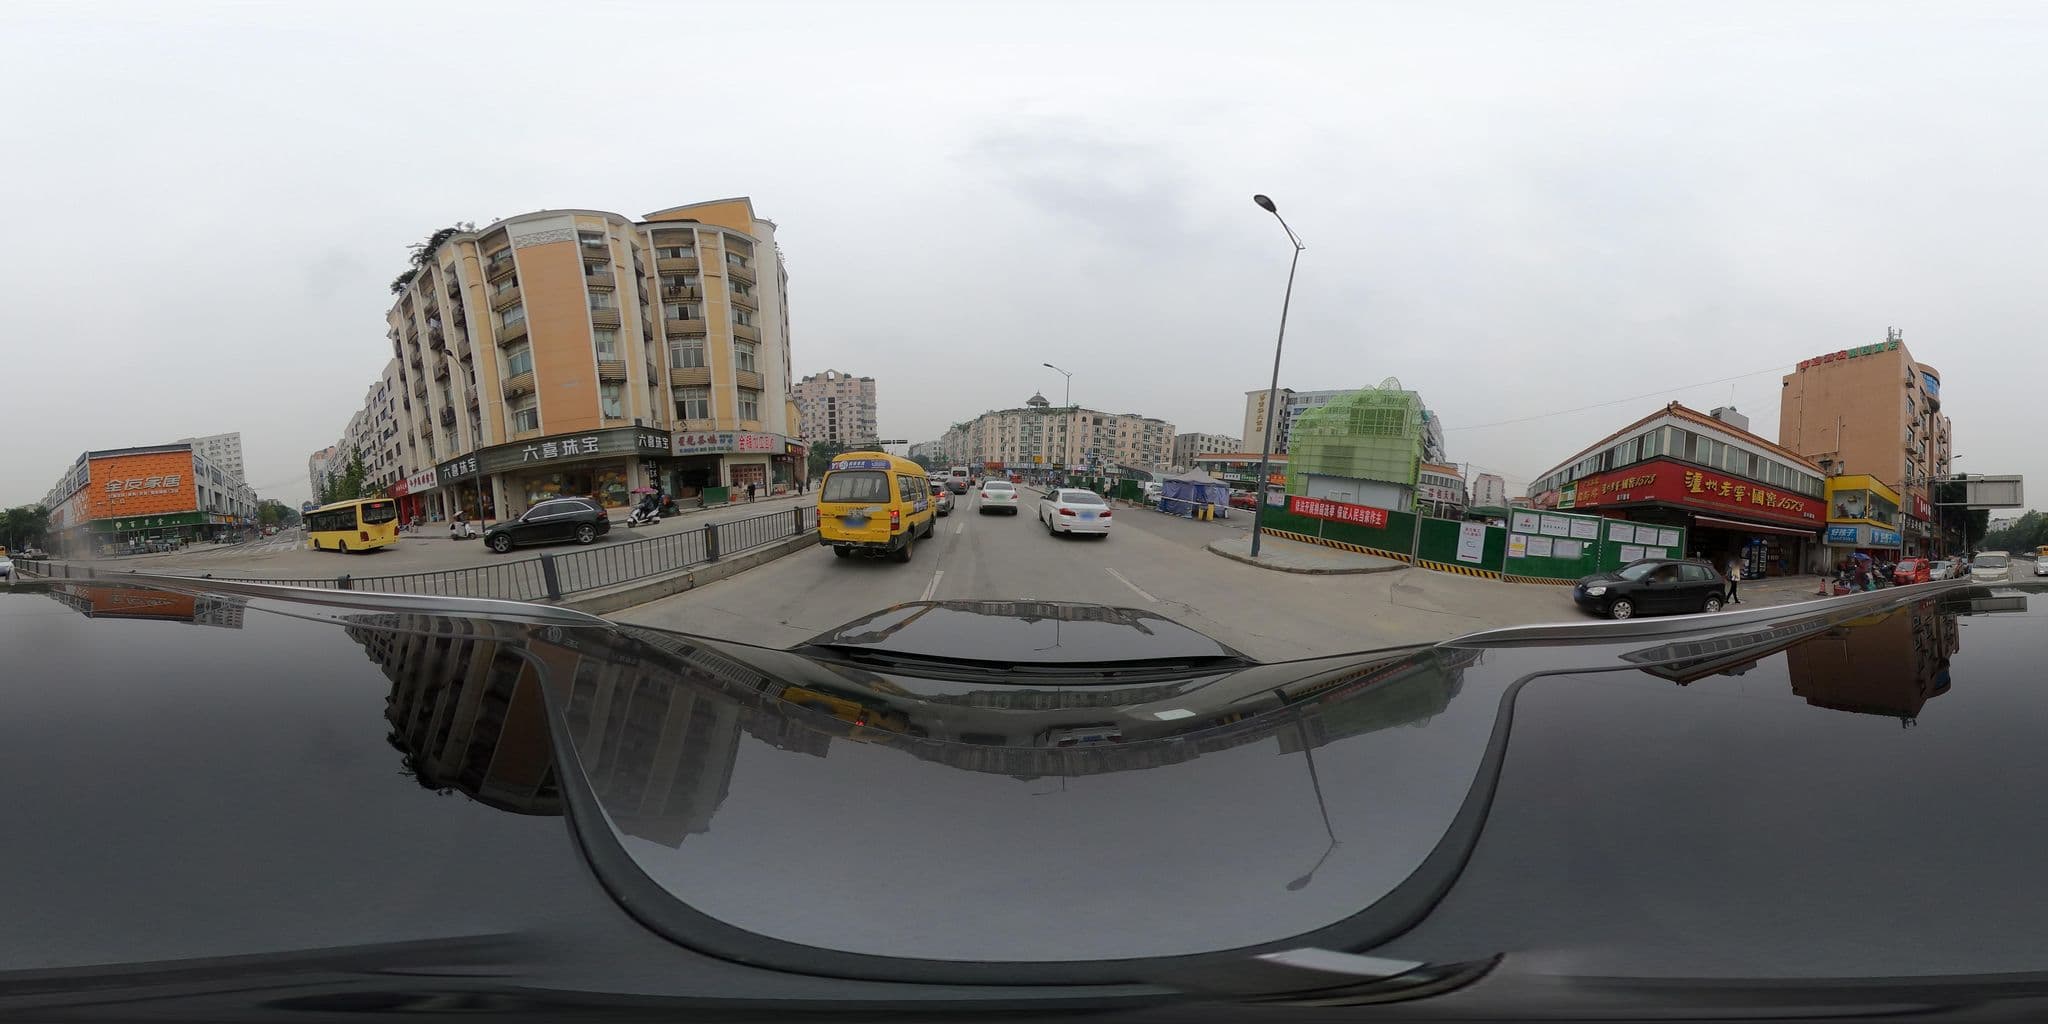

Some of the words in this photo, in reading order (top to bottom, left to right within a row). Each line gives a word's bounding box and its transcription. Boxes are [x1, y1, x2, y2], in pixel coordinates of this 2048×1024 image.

[522, 436, 599, 462] 六喜珠宝
[638, 433, 669, 449] 六喜珠宝
[442, 457, 476, 480] 六喜珠宝
[105, 475, 181, 493] 全友家居
[1336, 506, 1381, 525] 保证人民当家作主
